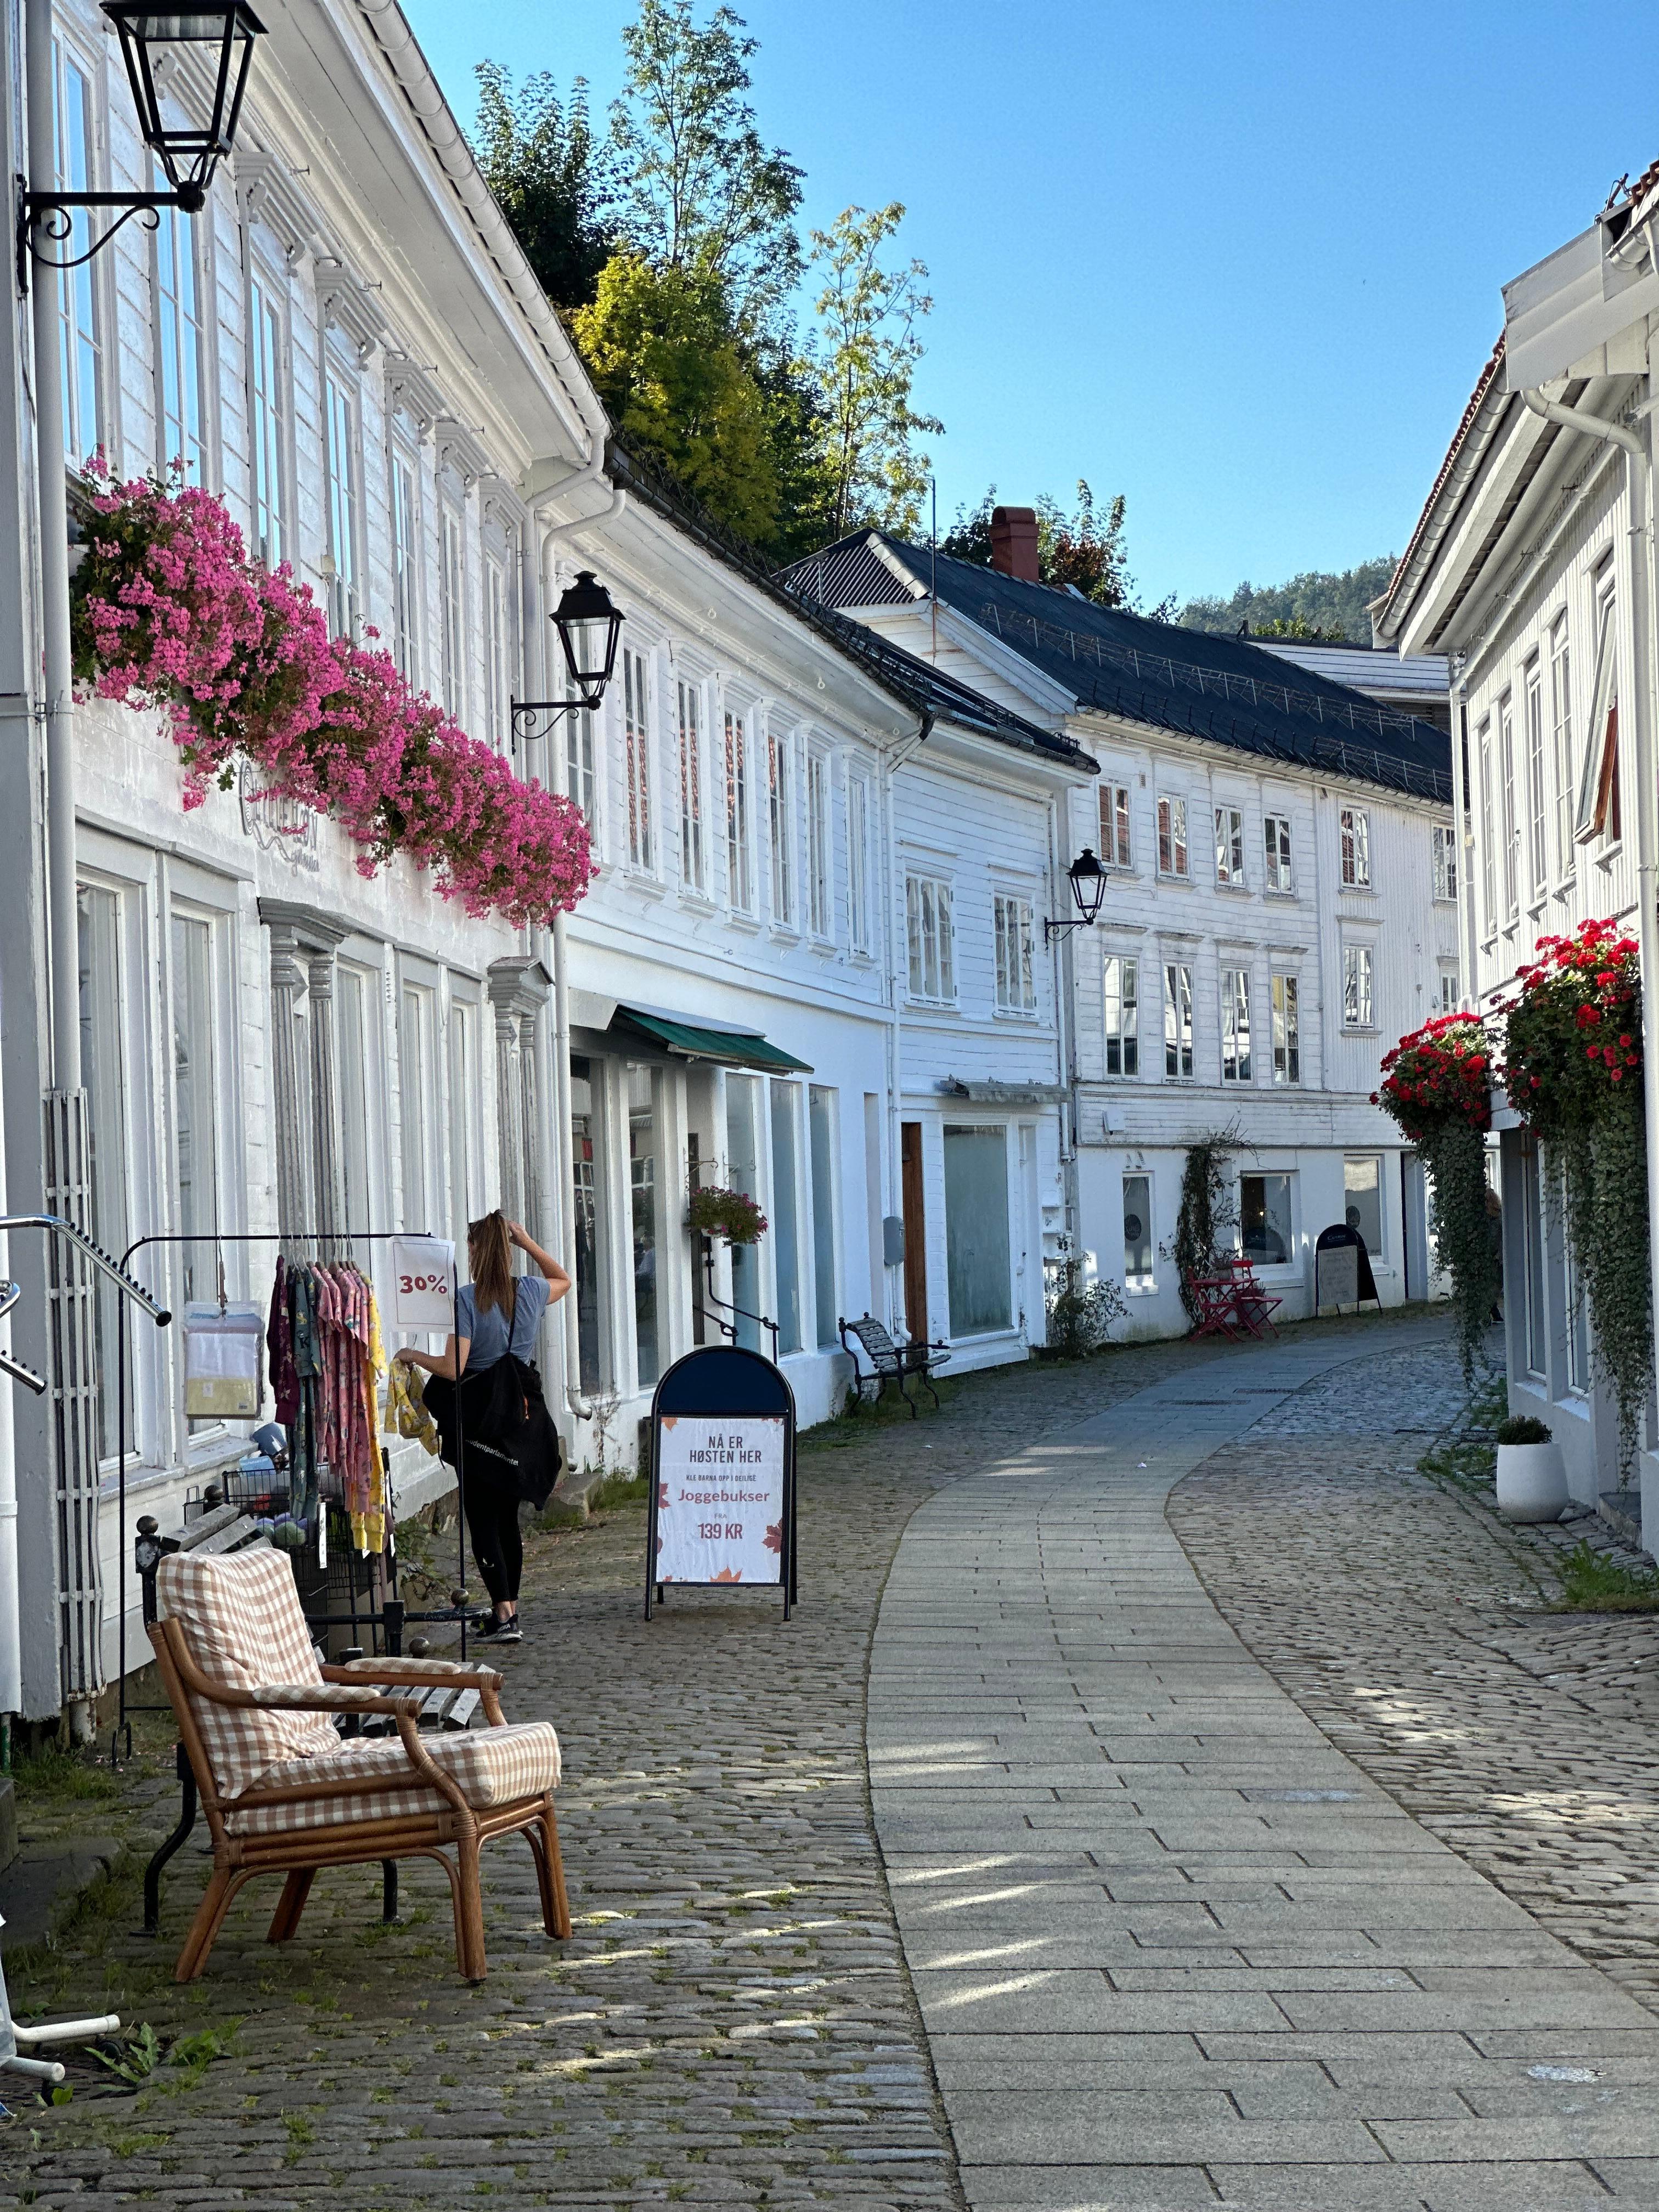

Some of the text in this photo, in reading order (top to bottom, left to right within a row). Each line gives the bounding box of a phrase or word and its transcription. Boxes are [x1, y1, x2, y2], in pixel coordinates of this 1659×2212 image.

[399, 1274, 447, 1294] 30%
[708, 1434, 743, 1448] NÅ ER
[690, 1450, 761, 1463] HØSTEN HER
[678, 1489, 770, 1504] Joggebukser
[698, 1523, 743, 1539] 139 KR
